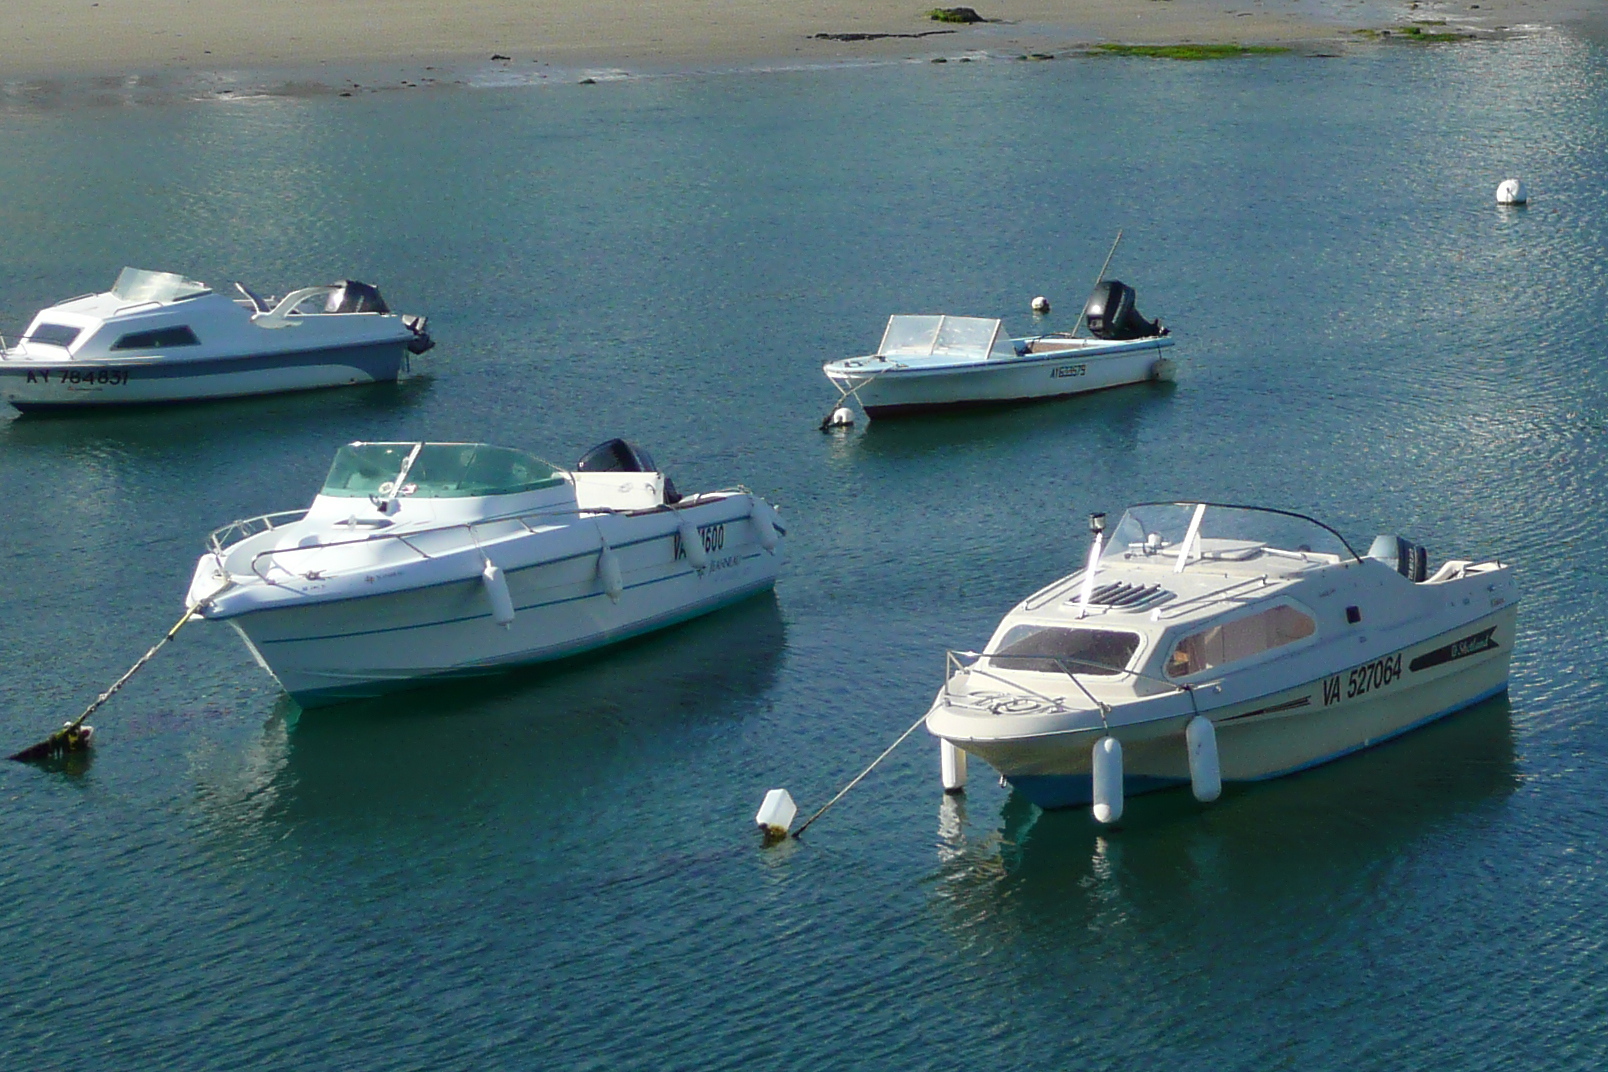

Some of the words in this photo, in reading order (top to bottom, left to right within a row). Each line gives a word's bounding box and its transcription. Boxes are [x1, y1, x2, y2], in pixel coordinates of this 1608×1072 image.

[26, 369, 50, 384] AY
[58, 369, 129, 385] 784831
[1323, 676, 1341, 706] VA
[1347, 652, 1402, 699] 527064
